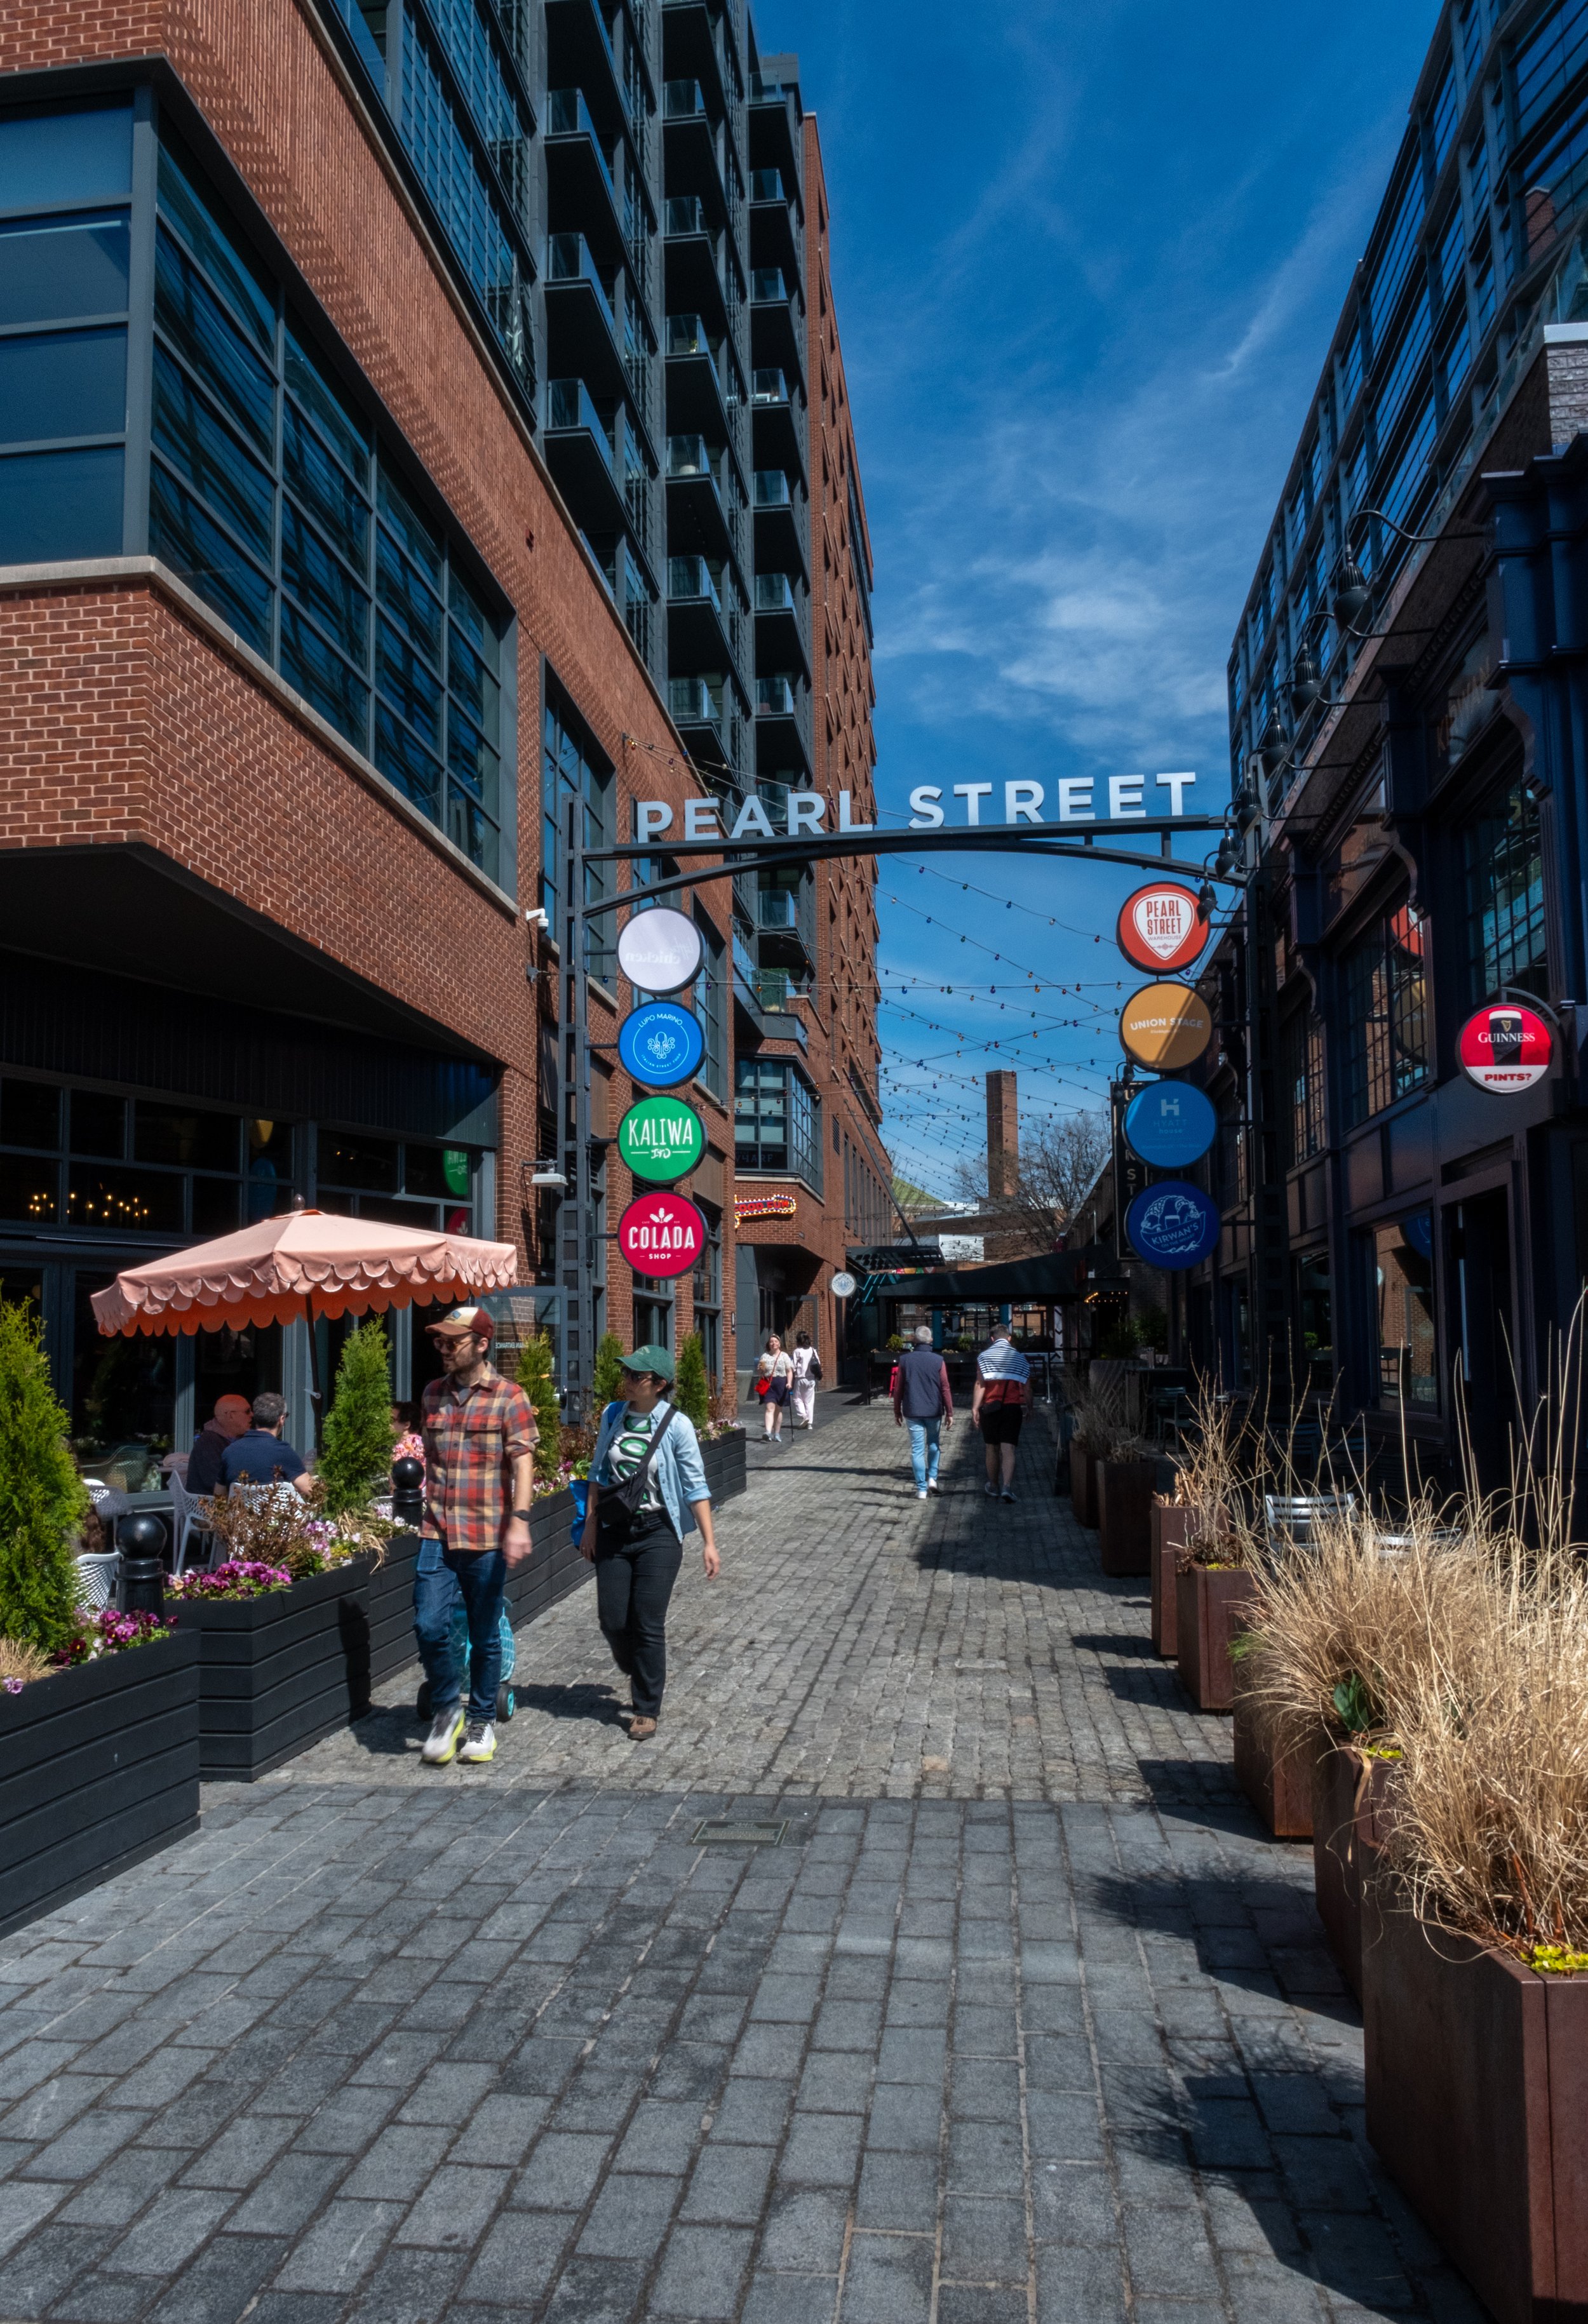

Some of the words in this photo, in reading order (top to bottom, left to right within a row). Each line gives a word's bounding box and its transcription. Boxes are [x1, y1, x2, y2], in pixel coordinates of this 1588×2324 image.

[638, 790, 873, 843] PEARL
[908, 772, 1196, 829] STREET
[1146, 899, 1181, 918] PEARL
[1147, 918, 1182, 936] STREET
[638, 1015, 656, 1028] LUPO
[657, 1014, 683, 1026] MARINO
[1129, 1018, 1166, 1031] UNION
[1169, 1018, 1204, 1028] STAGE
[1484, 1073, 1532, 1082] PINTS?
[628, 1117, 693, 1146] KALIWA
[1153, 1119, 1187, 1127] HYATT
[629, 1226, 695, 1249] COLADA
[1151, 1223, 1199, 1245] KIRWAN'S
